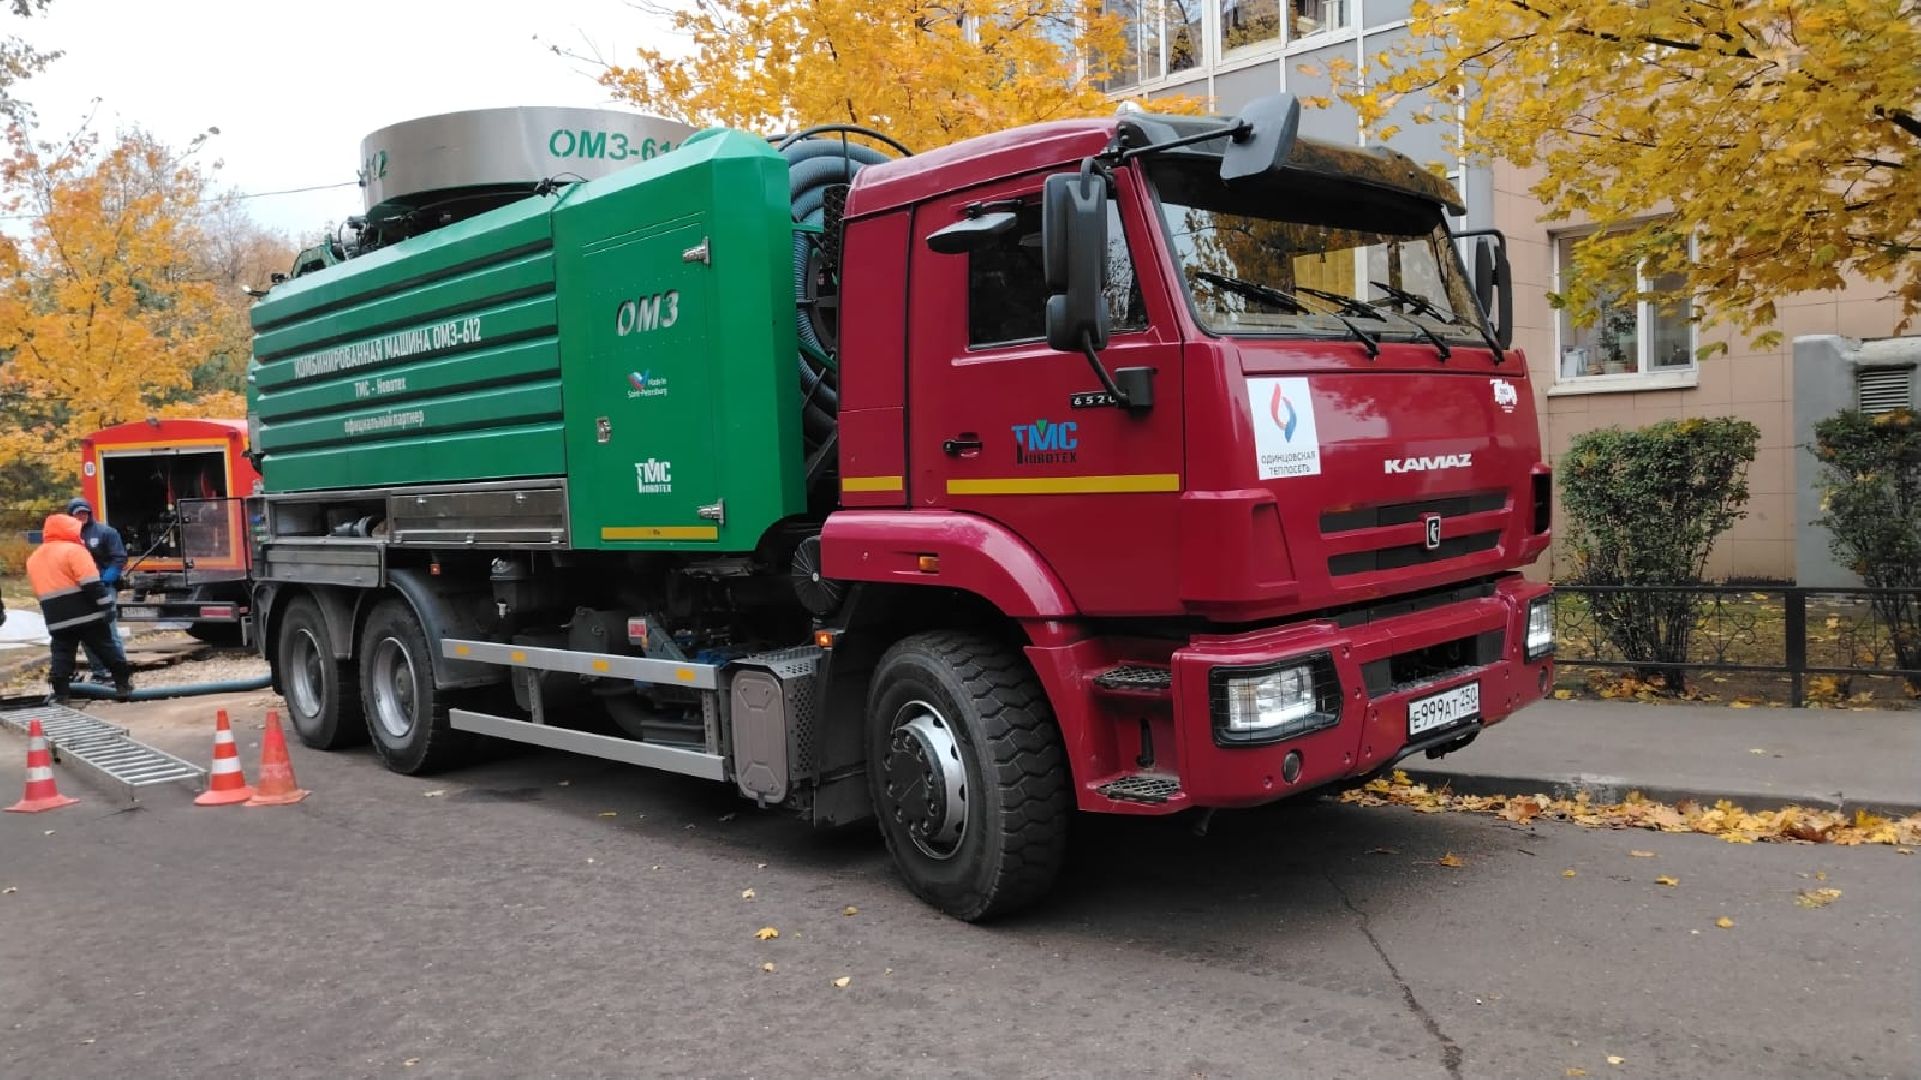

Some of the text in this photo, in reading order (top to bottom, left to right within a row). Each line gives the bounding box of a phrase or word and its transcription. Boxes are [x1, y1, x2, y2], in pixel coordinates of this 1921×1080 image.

[549, 129, 682, 160] ОМЗ-6
[616, 289, 680, 337] ОМЗ
[294, 318, 482, 379] КОМБИНИРОВАННАЯ МАШИНА ОМЗ-612
[1261, 451, 1315, 464] ОДИНЦОВСКАЯ
[1384, 453, 1472, 474] KAMAZ
[1269, 463, 1311, 475] ТЕПЛОСЕТЬ
[1460, 687, 1477, 707] 250
